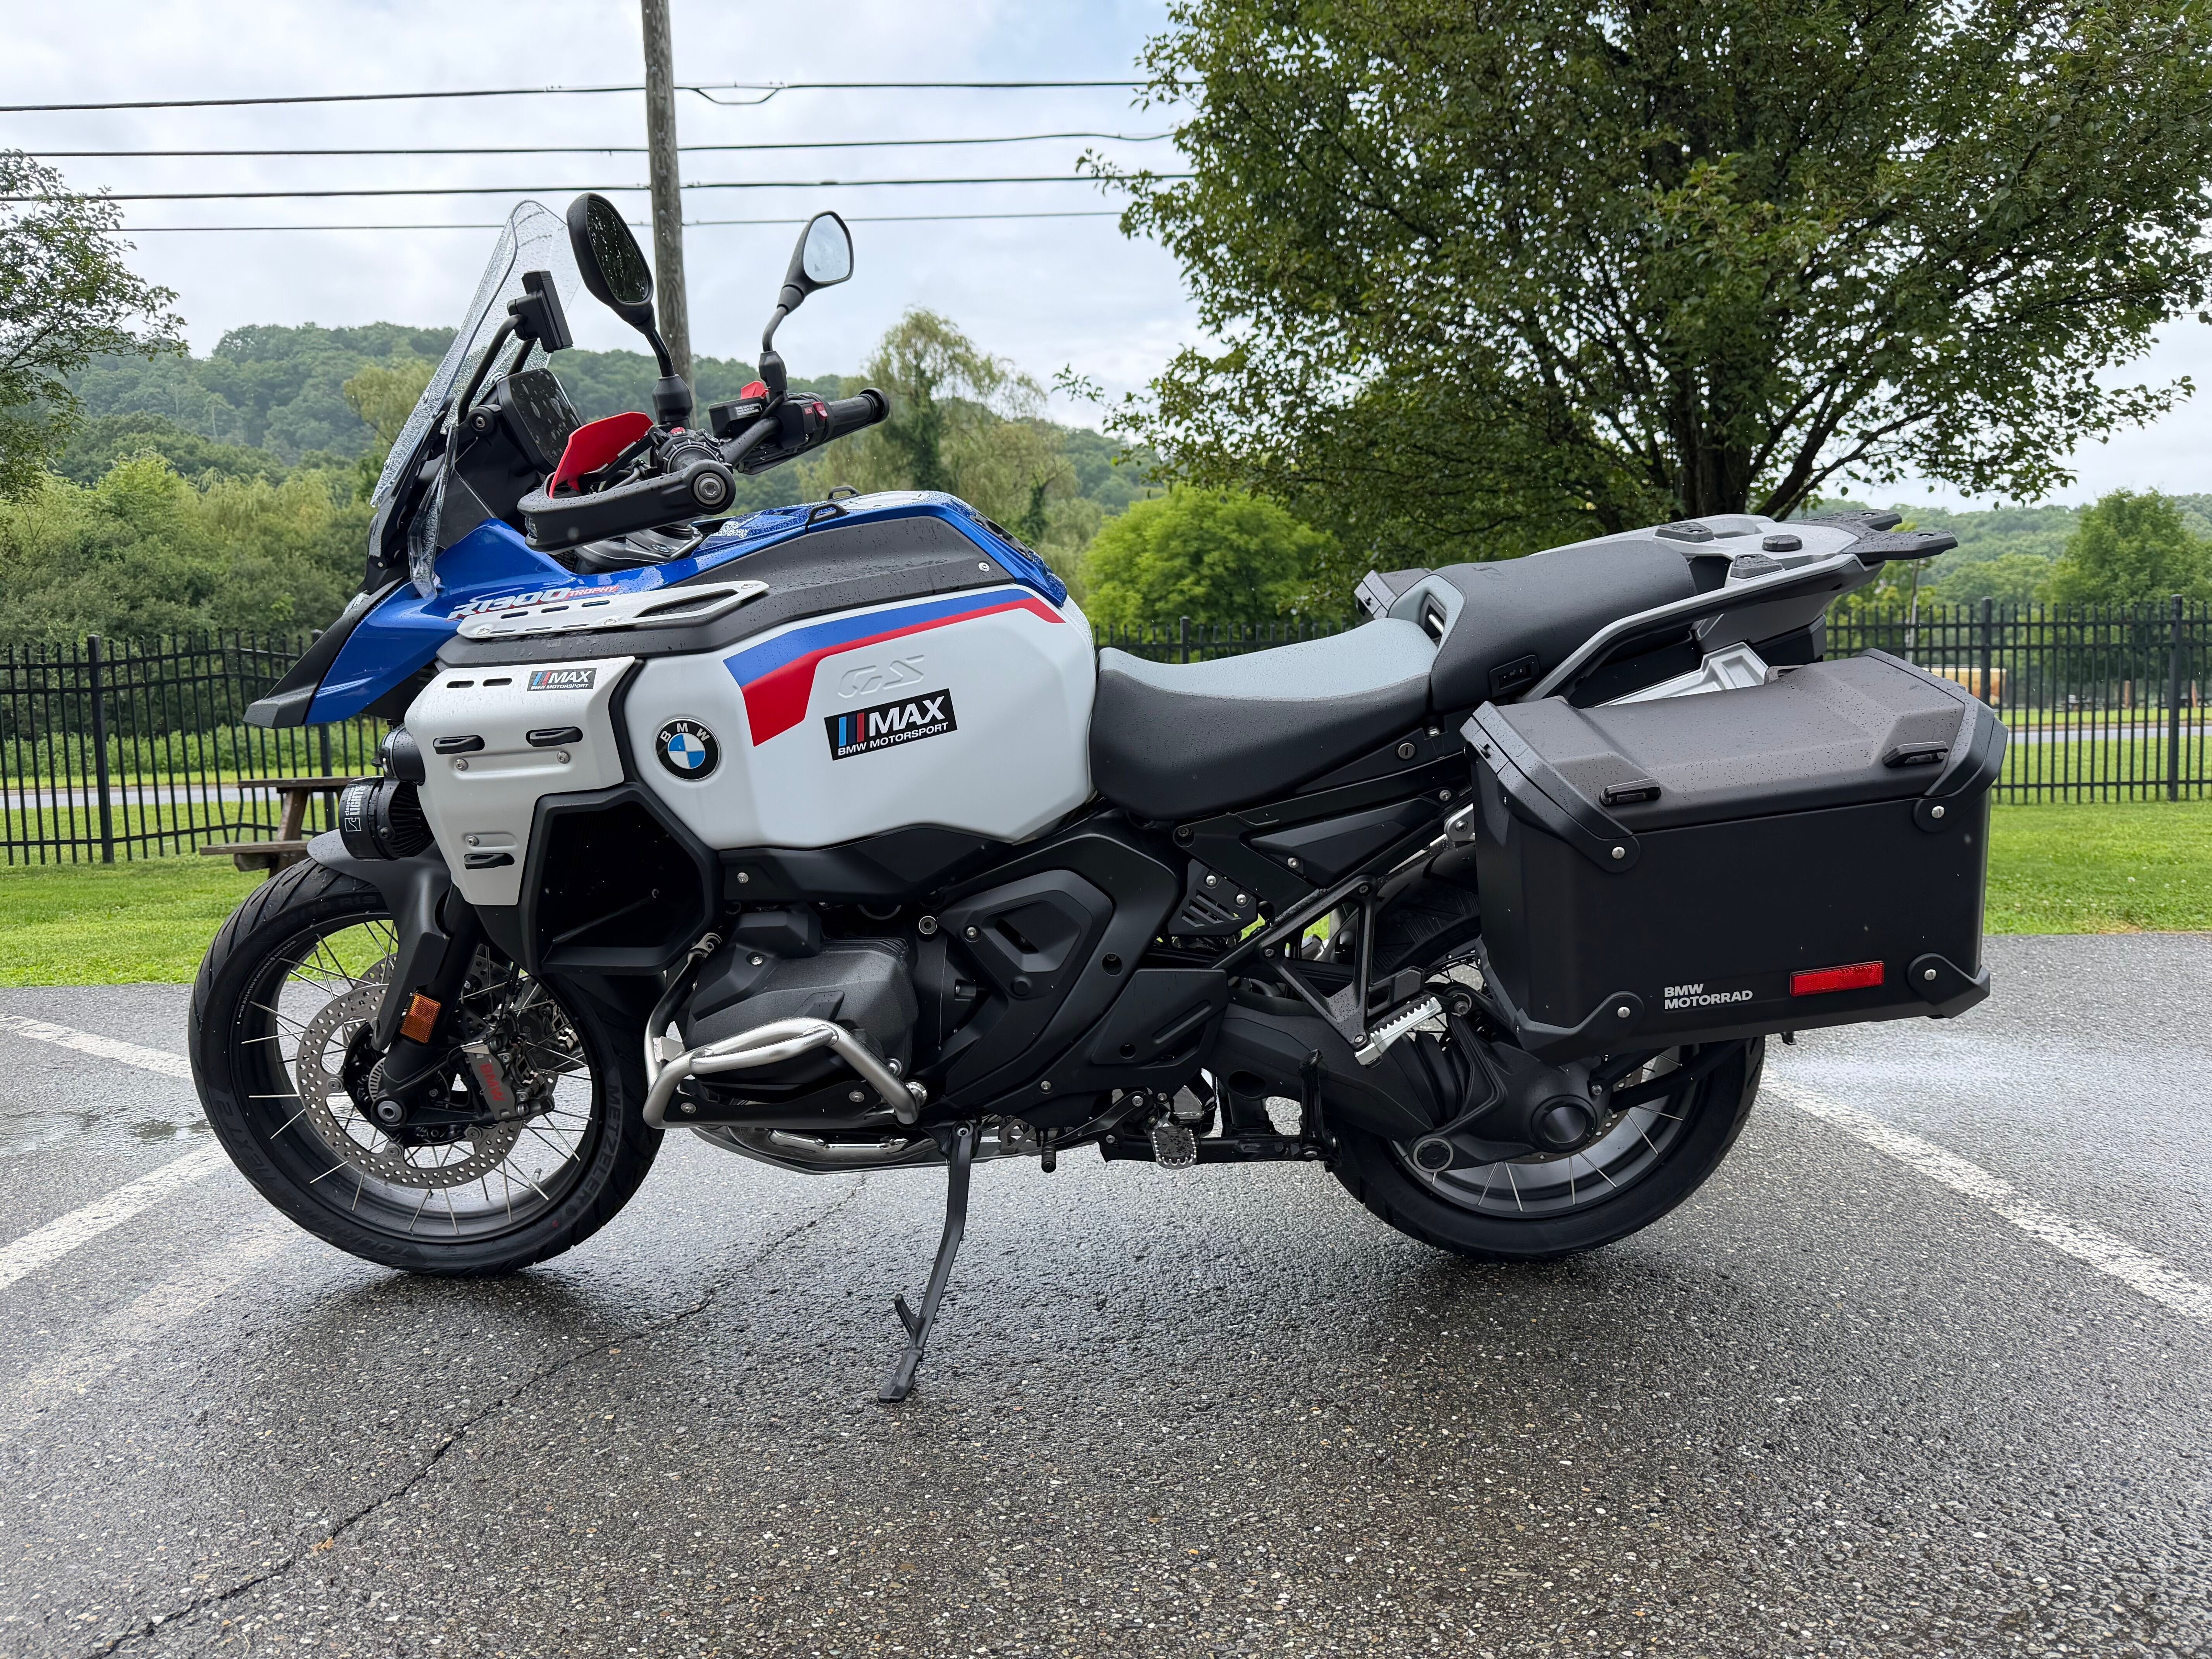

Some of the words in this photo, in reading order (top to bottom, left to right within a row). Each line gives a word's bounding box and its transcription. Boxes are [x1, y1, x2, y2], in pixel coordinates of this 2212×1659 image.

[568, 585, 620, 597] TROPHY
[548, 670, 592, 684] MAX
[838, 655, 924, 698] GS
[869, 696, 946, 737] MAX
[659, 723, 710, 743] BMW
[838, 741, 867, 756] BMW
[869, 721, 949, 749] MOTORSPORT
[349, 786, 367, 816] LIGHTS
[1664, 983, 1704, 998] BMW
[1664, 989, 1753, 1010] MOTORRAD
[480, 1063, 506, 1101] BMW
[575, 1084, 621, 1205] METZELER
